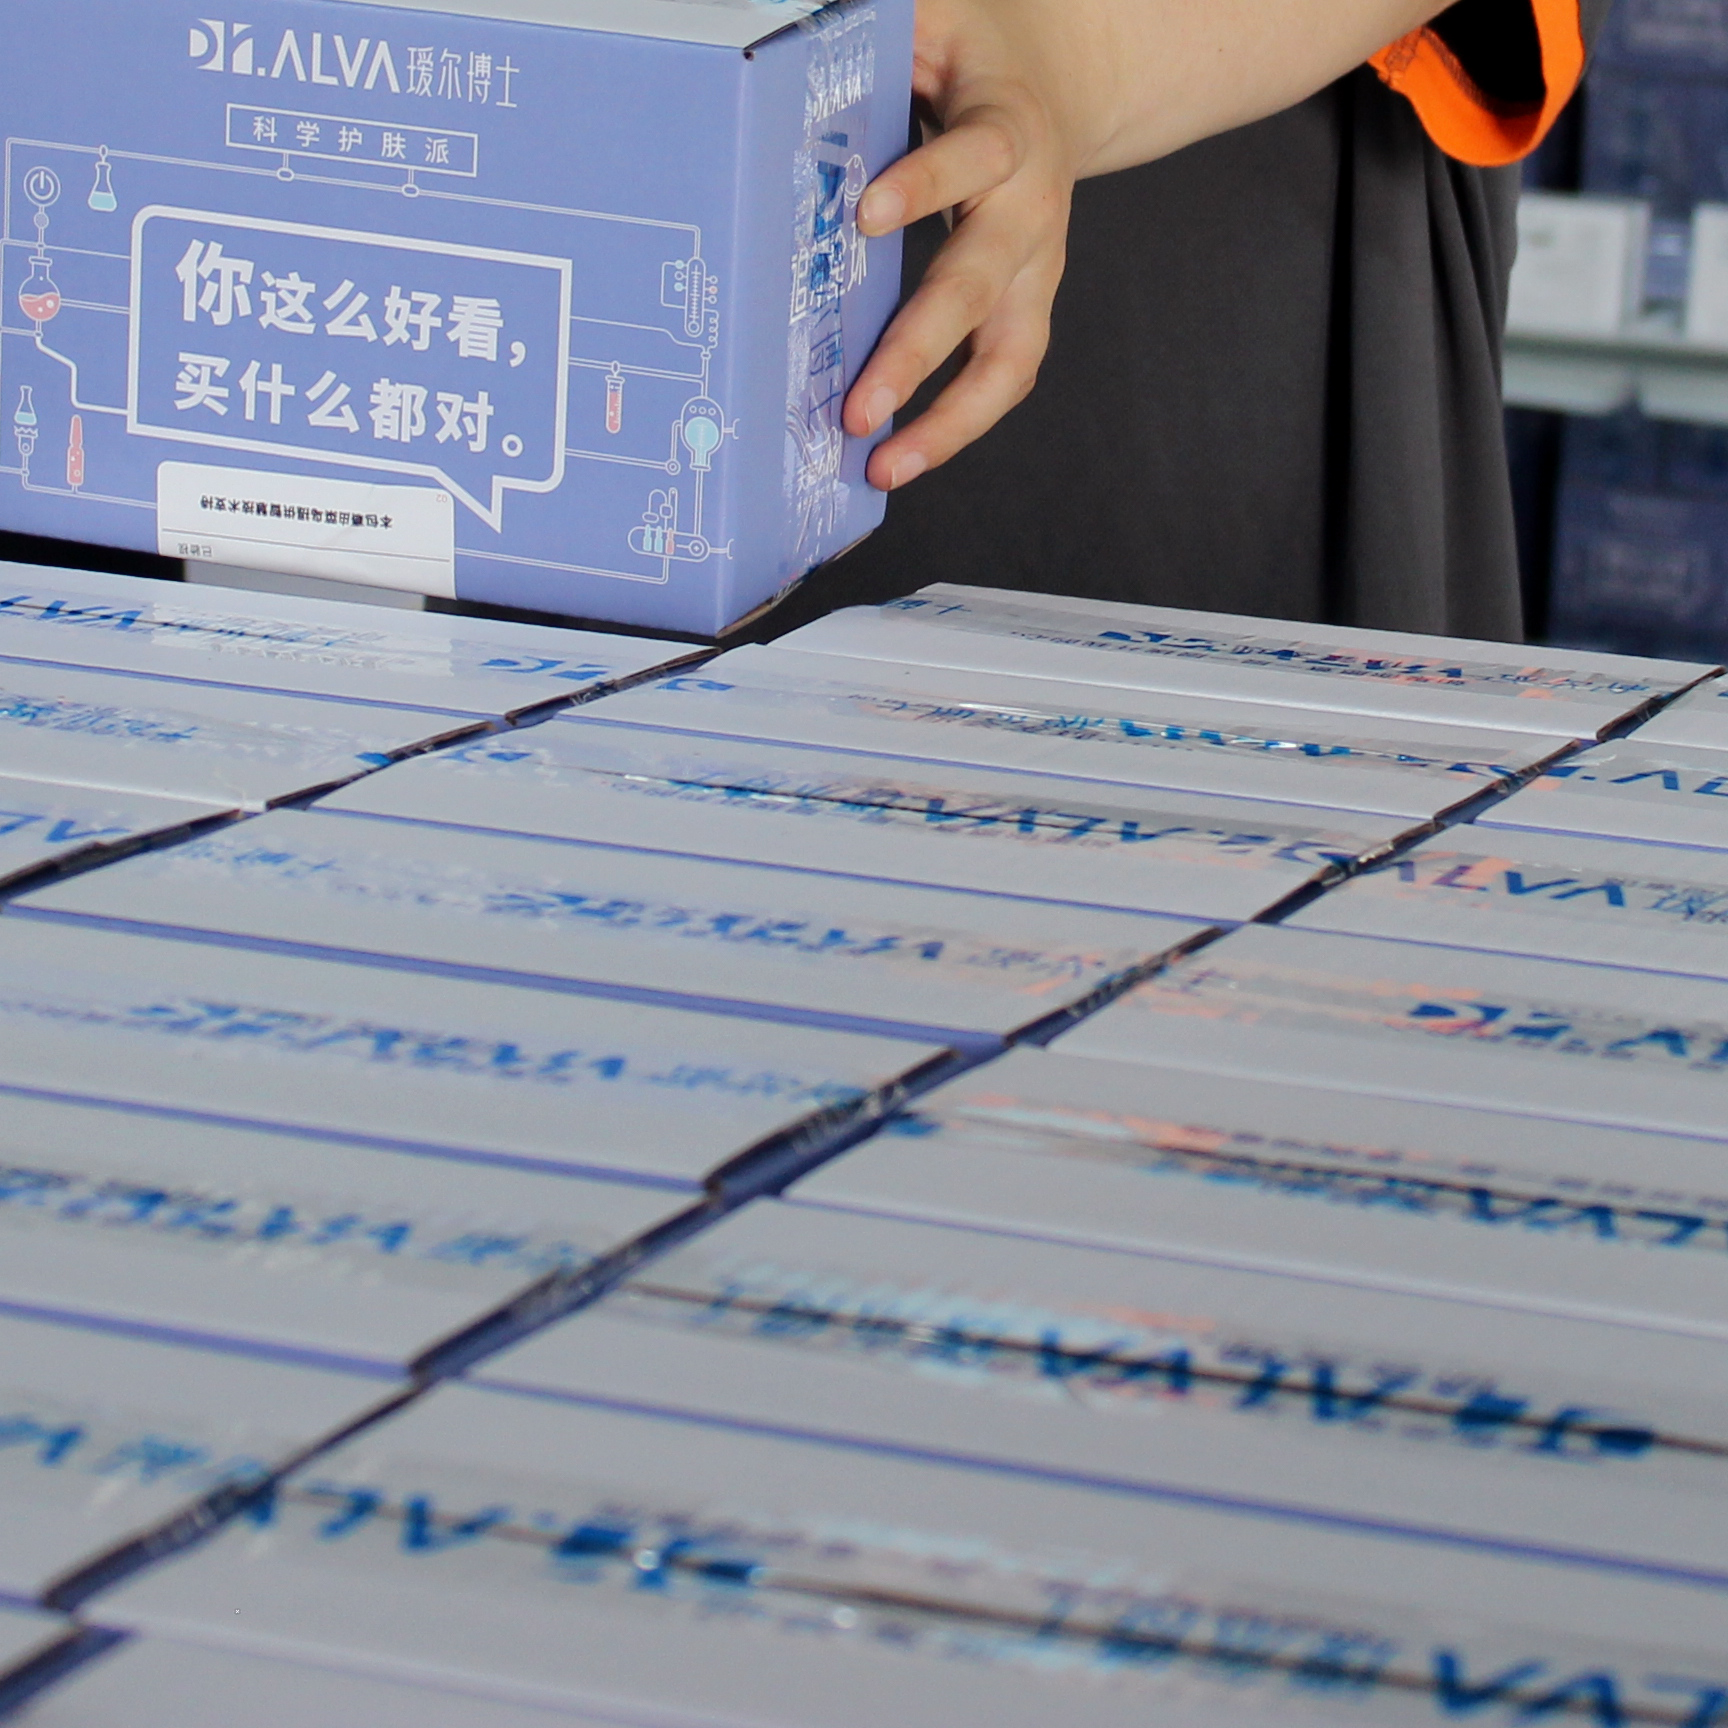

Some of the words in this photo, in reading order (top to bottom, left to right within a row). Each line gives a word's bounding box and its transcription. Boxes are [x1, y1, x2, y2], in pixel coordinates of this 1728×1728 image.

[252, 115, 451, 165] 科学护肤派
[173, 351, 524, 459] 买什么都对。
